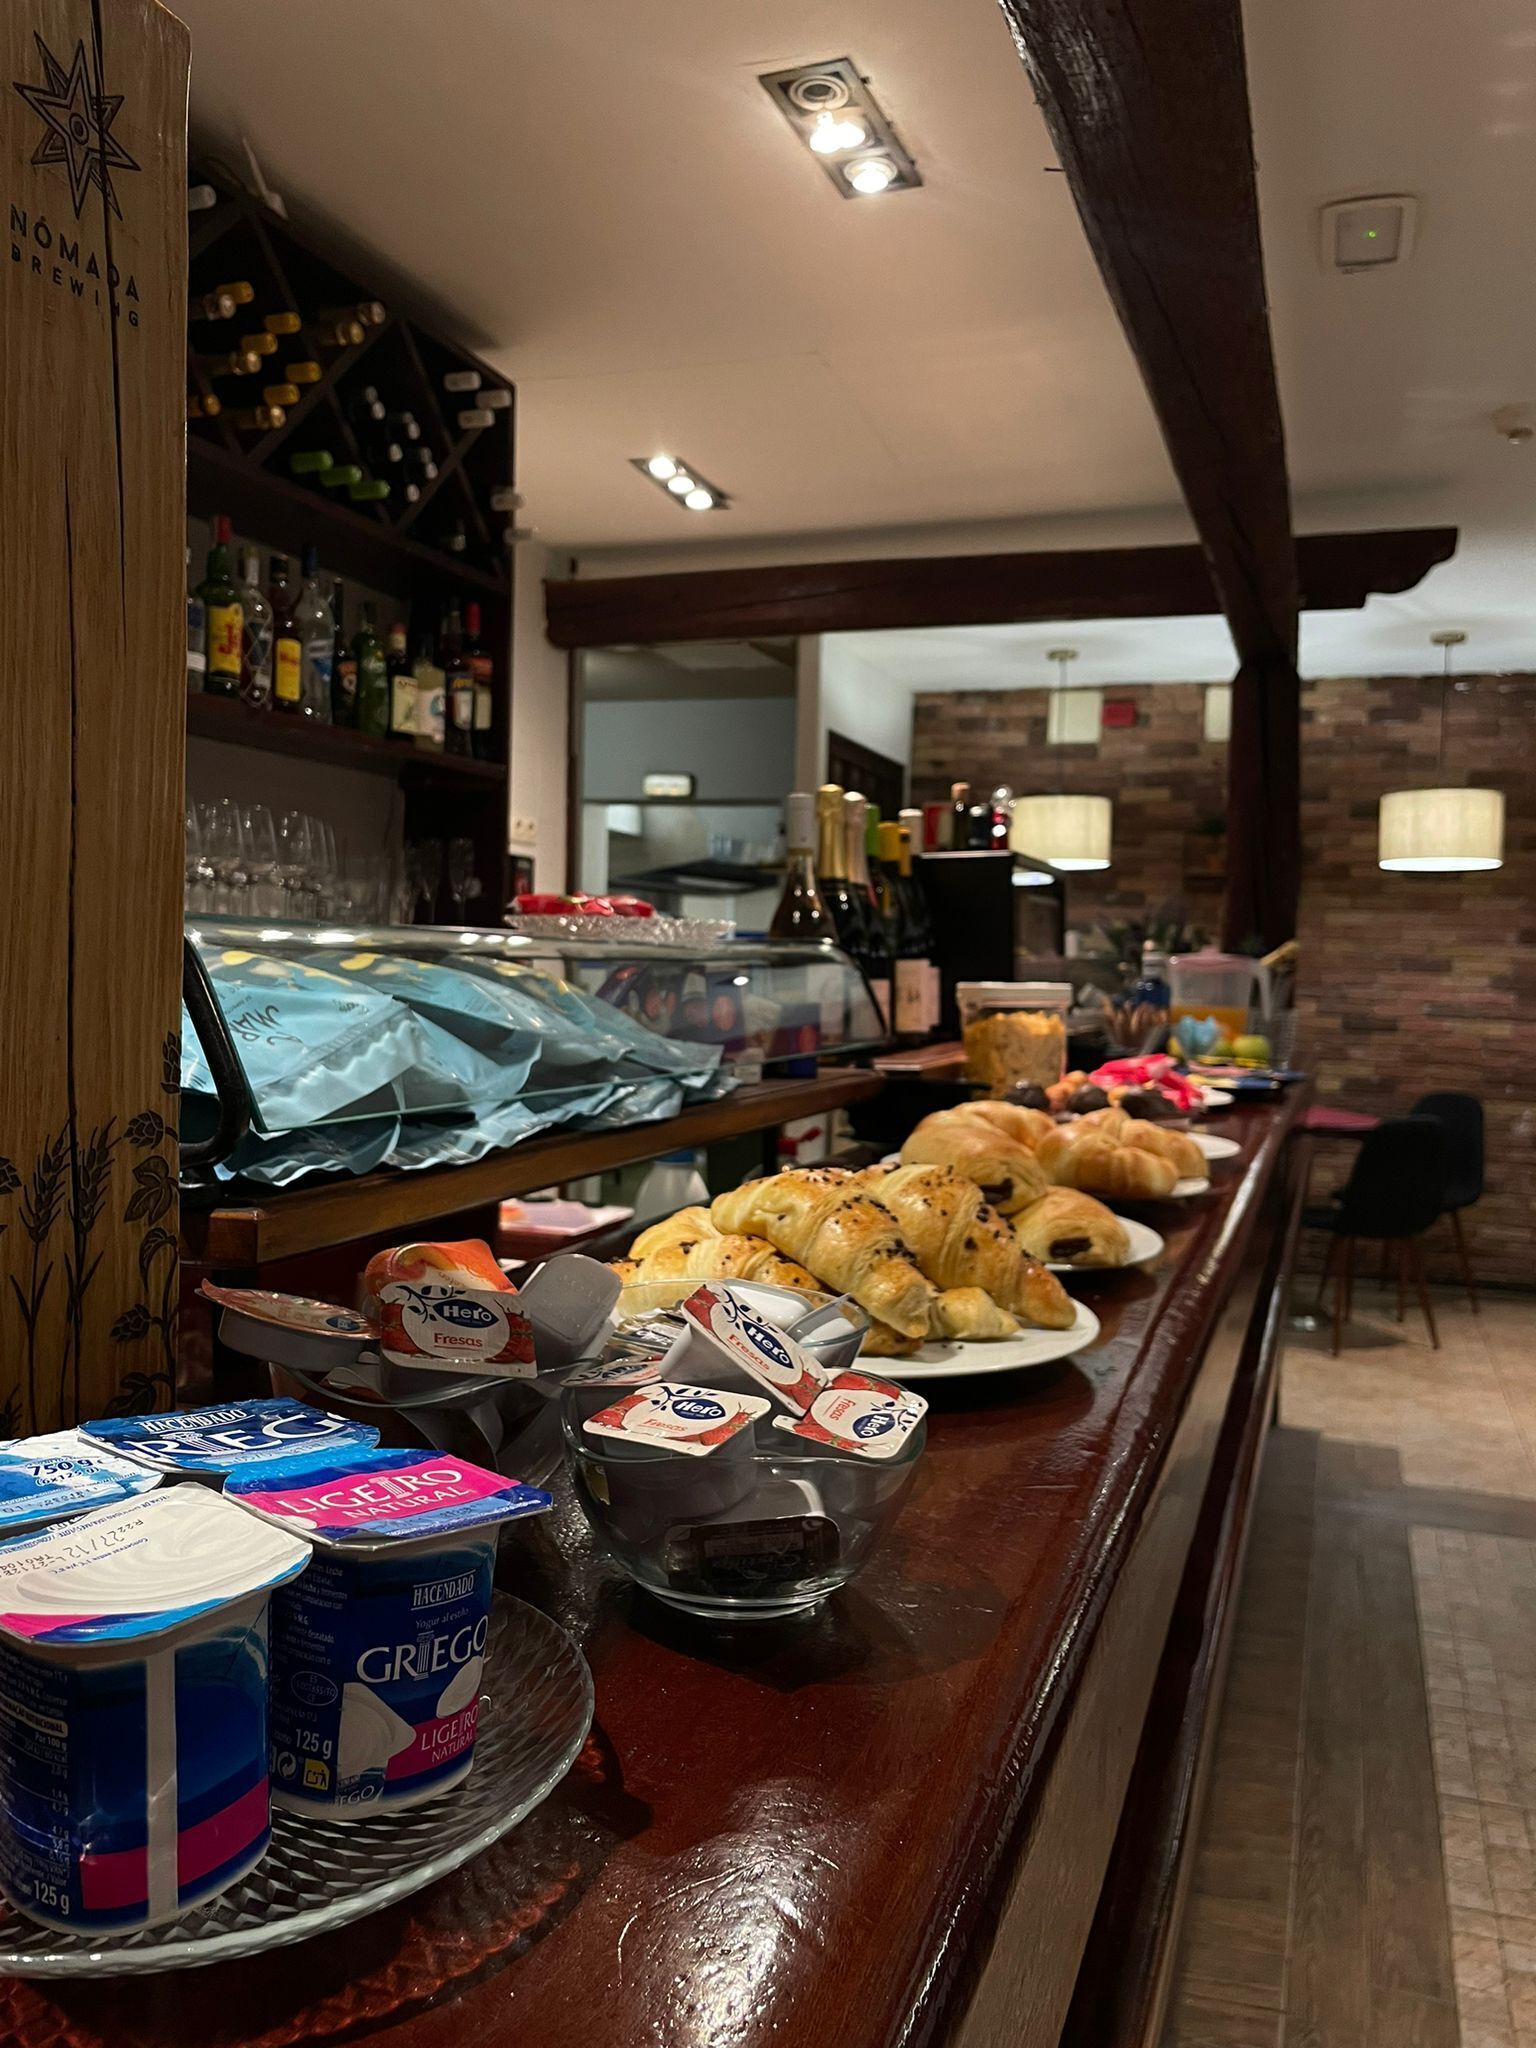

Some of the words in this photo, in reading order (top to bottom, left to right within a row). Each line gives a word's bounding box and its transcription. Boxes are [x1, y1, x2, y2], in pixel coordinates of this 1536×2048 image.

[11, 203, 139, 302] NÓMADA
[11, 243, 138, 327] BREWING
[441, 1304, 493, 1323] Hero
[433, 1332, 483, 1348] Fresas
[727, 1333, 770, 1371] Fresas
[745, 1326, 791, 1364] Hero
[139, 1409, 247, 1432] HACENDADO
[674, 1400, 723, 1416] Hero
[831, 1398, 856, 1421] Fresas
[122, 1411, 350, 1459] RIEG
[642, 1418, 688, 1432] Fresas
[861, 1414, 890, 1437] Hero
[28, 1461, 73, 1476] 750
[78, 1459, 94, 1467] g
[277, 1469, 463, 1513] LIGEIRO
[342, 1486, 471, 1520] NATURAL
[413, 1574, 475, 1606] HACENDADO
[416, 1617, 439, 1631] Yogur
[442, 1613, 449, 1623] al
[356, 1614, 488, 1683] GRIEGO
[421, 1704, 478, 1751] LIGEIRO
[295, 1728, 320, 1753] 125
[322, 1740, 333, 1760] g
[431, 1730, 473, 1763] NATURAL
[33, 1880, 57, 1907] 125
[61, 1893, 70, 1916] g
